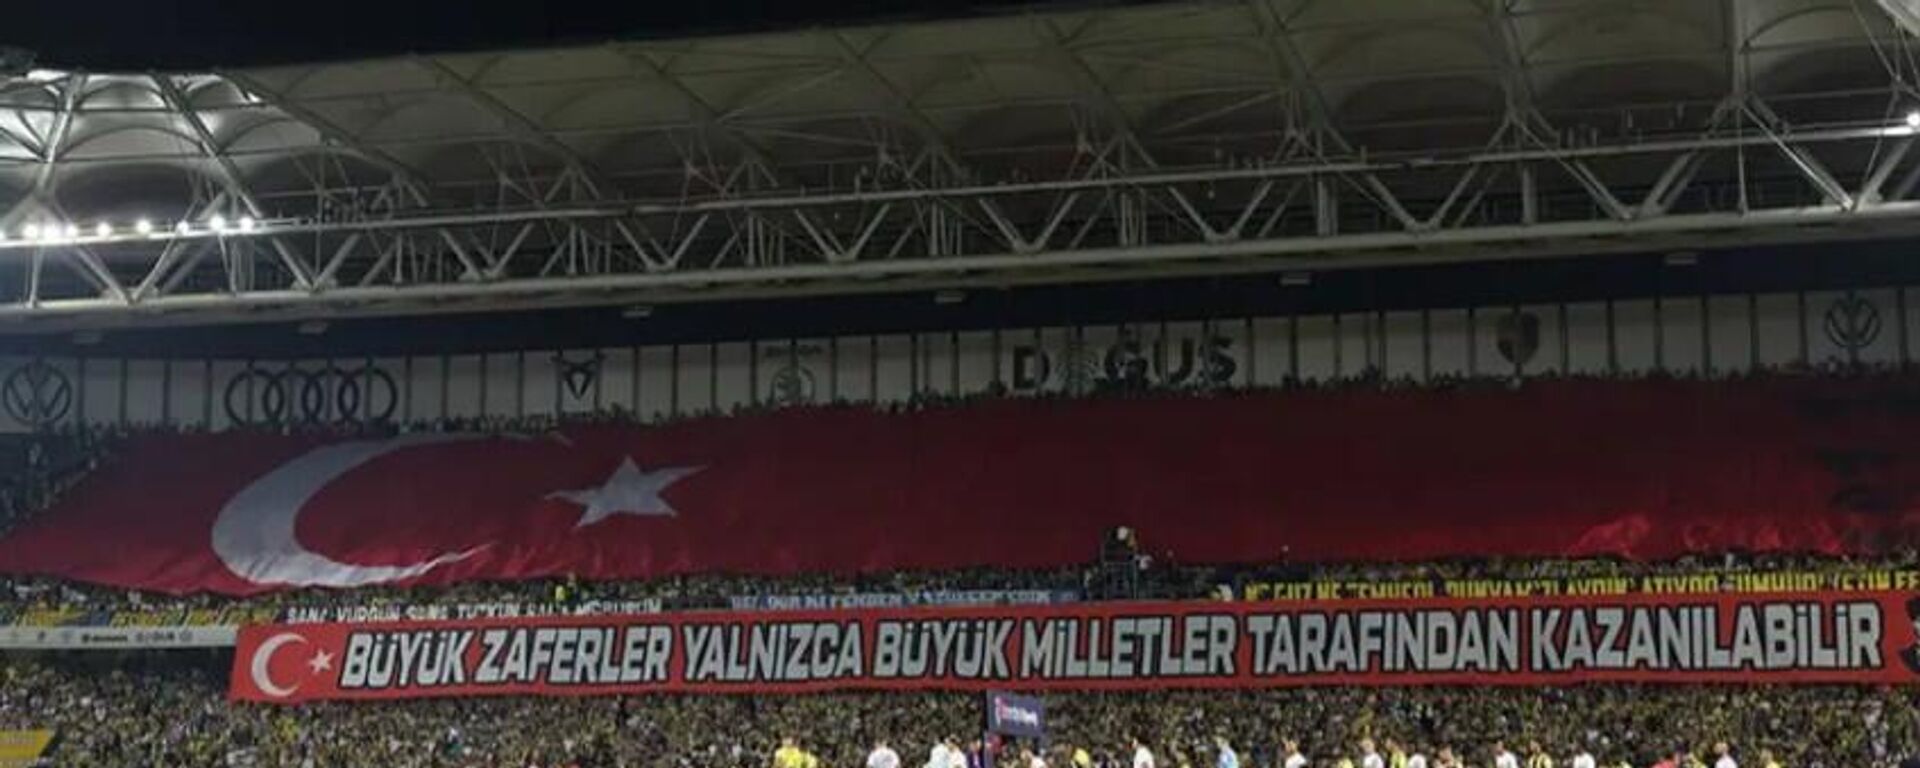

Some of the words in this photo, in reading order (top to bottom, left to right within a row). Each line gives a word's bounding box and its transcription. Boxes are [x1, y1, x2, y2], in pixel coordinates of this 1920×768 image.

[339, 632, 474, 688] BÜYÜK
[475, 626, 672, 685] ZAFERLER
[682, 621, 864, 681] YALNIZCA
[875, 618, 1014, 679] BÜYÜK
[1247, 608, 1520, 675] TARAFINDAN
